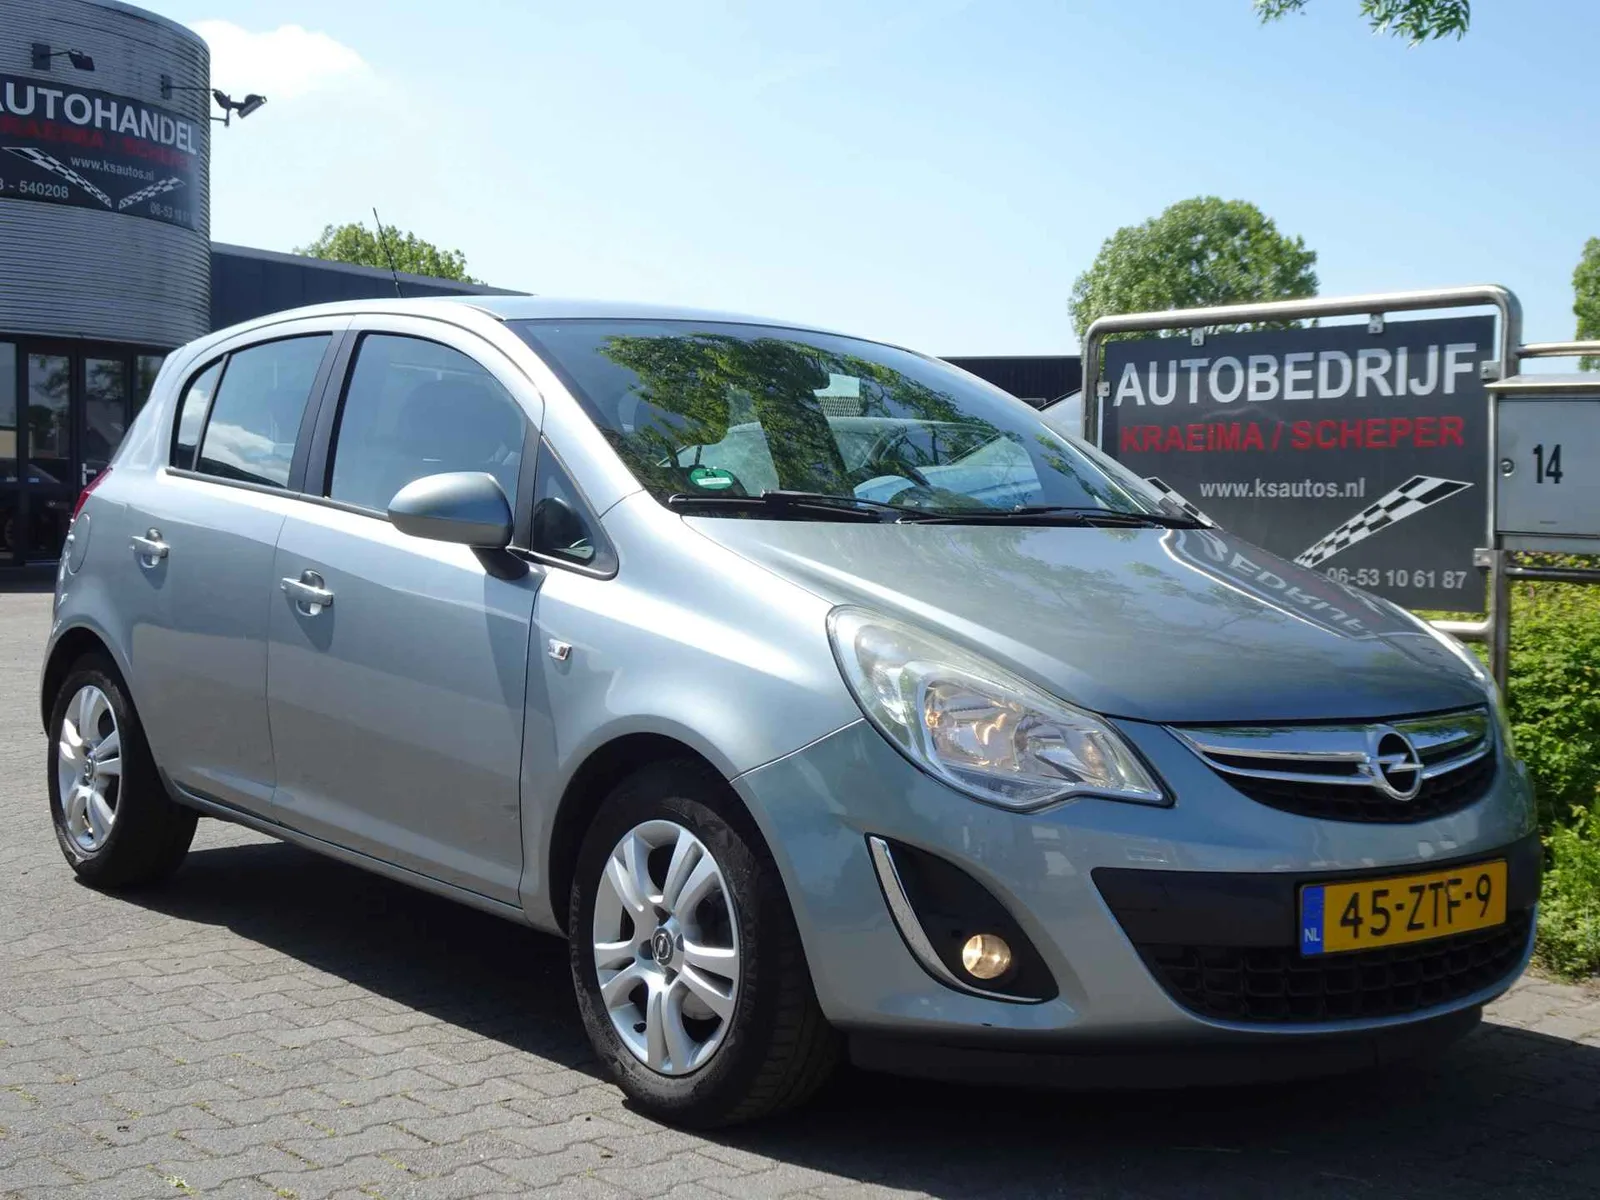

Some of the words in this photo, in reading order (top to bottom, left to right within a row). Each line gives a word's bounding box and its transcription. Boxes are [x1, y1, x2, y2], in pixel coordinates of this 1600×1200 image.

[0, 82, 197, 155] UTOHANDEL
[70, 156, 154, 181] www.ksautos.nl
[1113, 343, 1477, 407] AUTOBEDRIJF
[1120, 422, 1264, 452] KRAEIMA
[1290, 416, 1465, 449] SCHEPER
[1532, 443, 1563, 484] 14
[1200, 477, 1366, 498] www.ksautos.nl
[1327, 567, 1380, 586] 06-53
[1386, 569, 1409, 588] 10
[1413, 569, 1436, 588] 61
[1442, 570, 1468, 589] 87
[1340, 874, 1492, 940] 45-ZTF-9
[1304, 927, 1321, 943] NL
